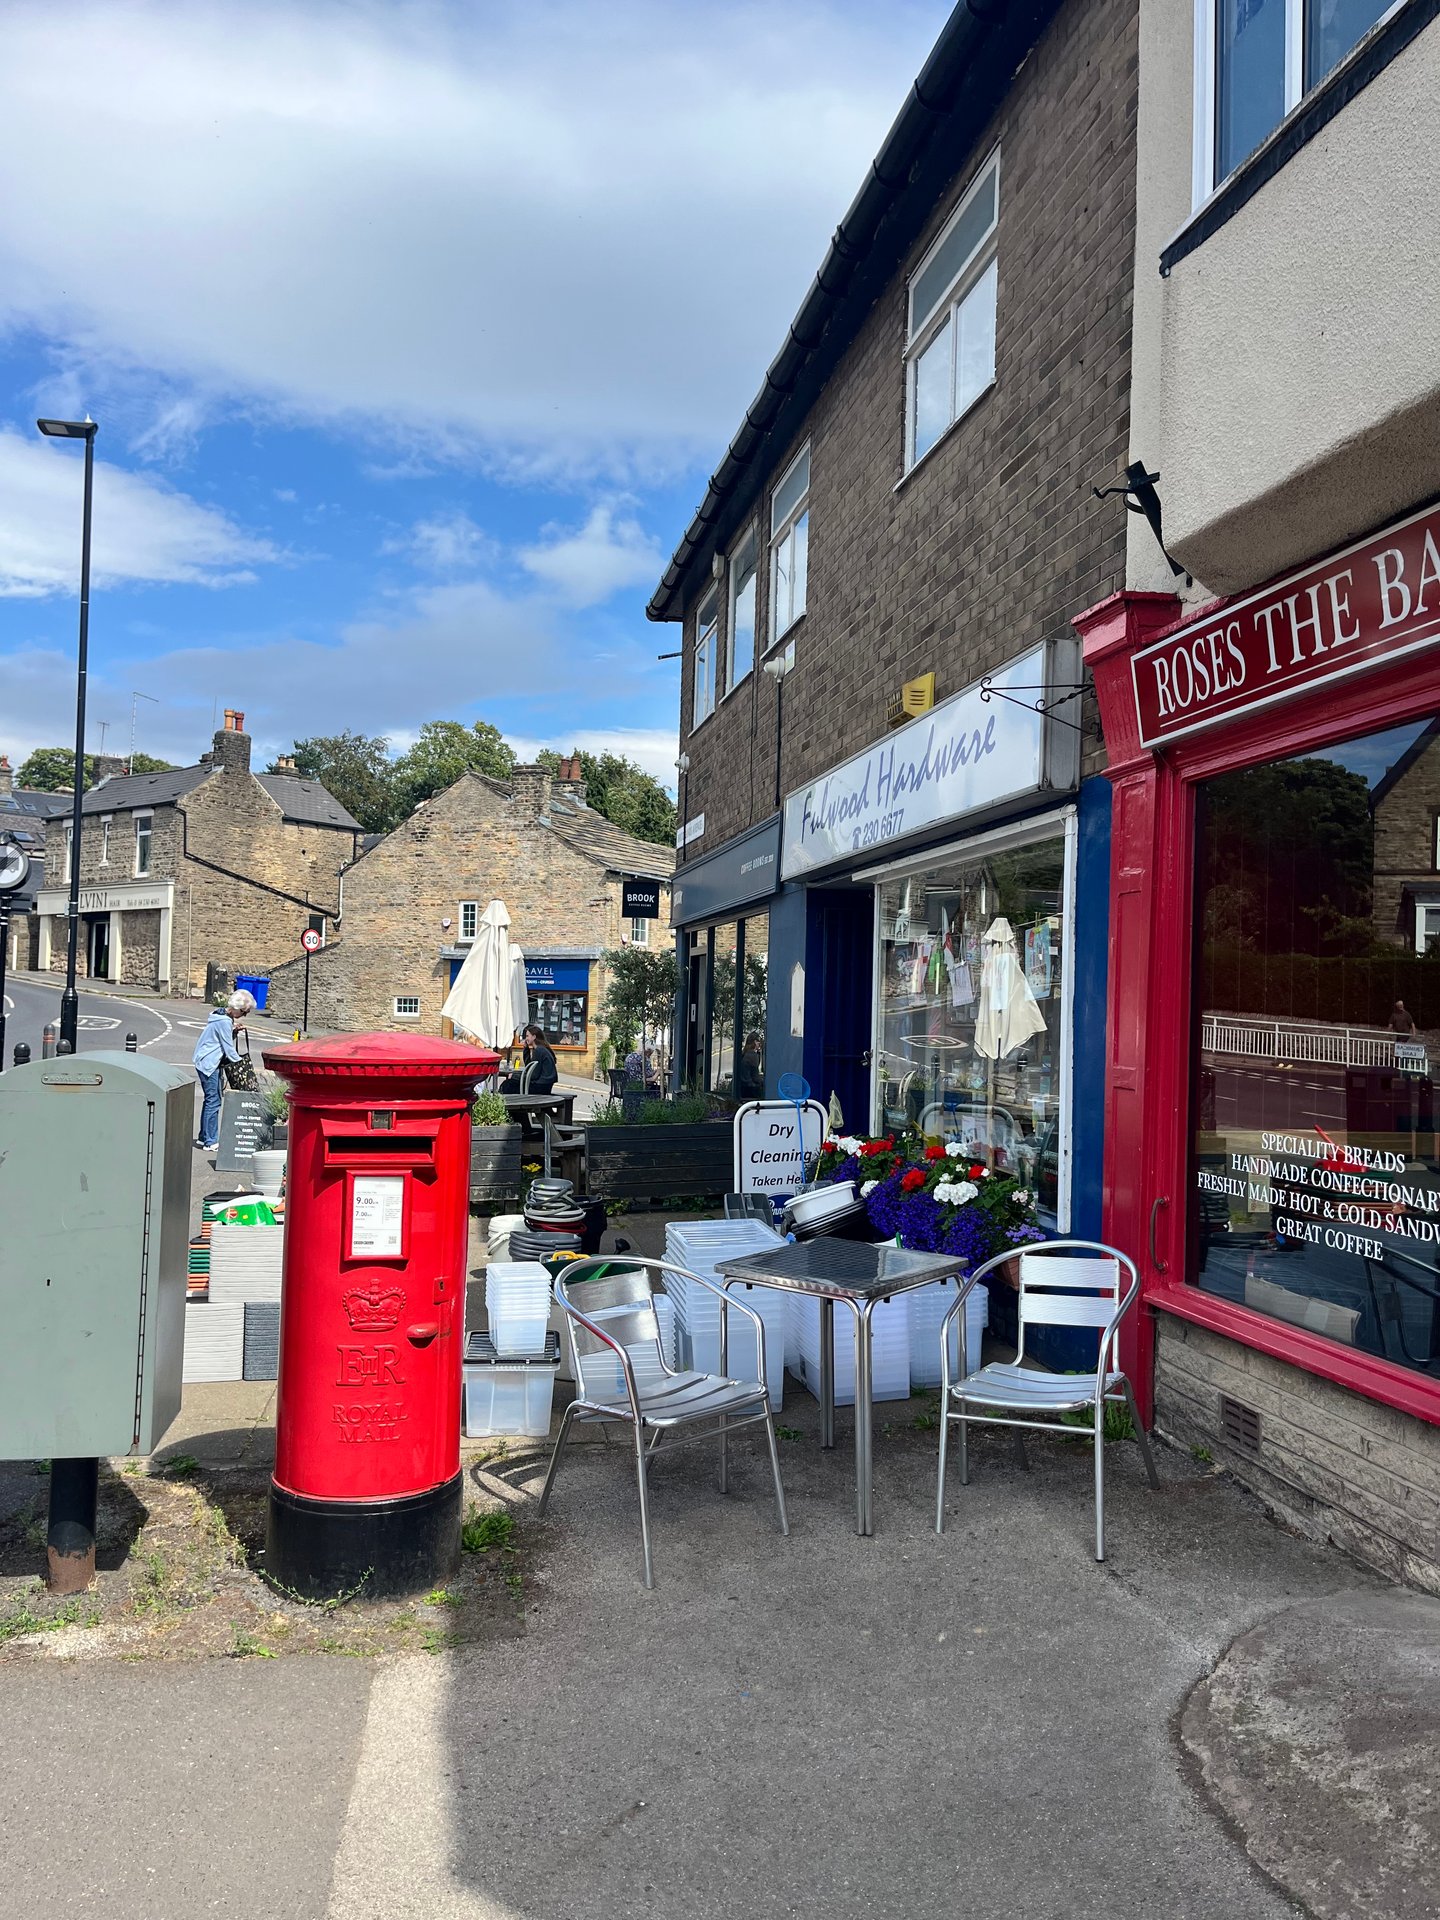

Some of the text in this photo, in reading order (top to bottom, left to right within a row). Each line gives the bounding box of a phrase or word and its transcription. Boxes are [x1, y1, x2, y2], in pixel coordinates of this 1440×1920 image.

[1152, 621, 1246, 717] ROSES
[1254, 569, 1360, 674] THE
[801, 715, 996, 843] Fulwood Hardware
[862, 808, 905, 846] 230 6677
[68, 892, 107, 908] LVINI
[627, 893, 655, 903] BROOK
[306, 935, 318, 945] 30
[525, 967, 554, 975] RAVEL
[769, 1124, 794, 1139] Dry
[751, 1149, 812, 1164] Cleaning
[1261, 1132, 1405, 1174] SPECIALITY BREADS
[1231, 1153, 1308, 1184] HANDMADE
[752, 1175, 786, 1187] Taken
[1197, 1171, 1247, 1198] FRESHLY
[1248, 1182, 1287, 1207] MADE
[1289, 1191, 1321, 1215] HOT
[1323, 1200, 1335, 1219] &
[1338, 1202, 1381, 1229] COLD
[1276, 1216, 1384, 1261] GREAT COFFEE
[331, 1403, 408, 1424] ROYAL
[338, 1423, 401, 1443] MAIL
